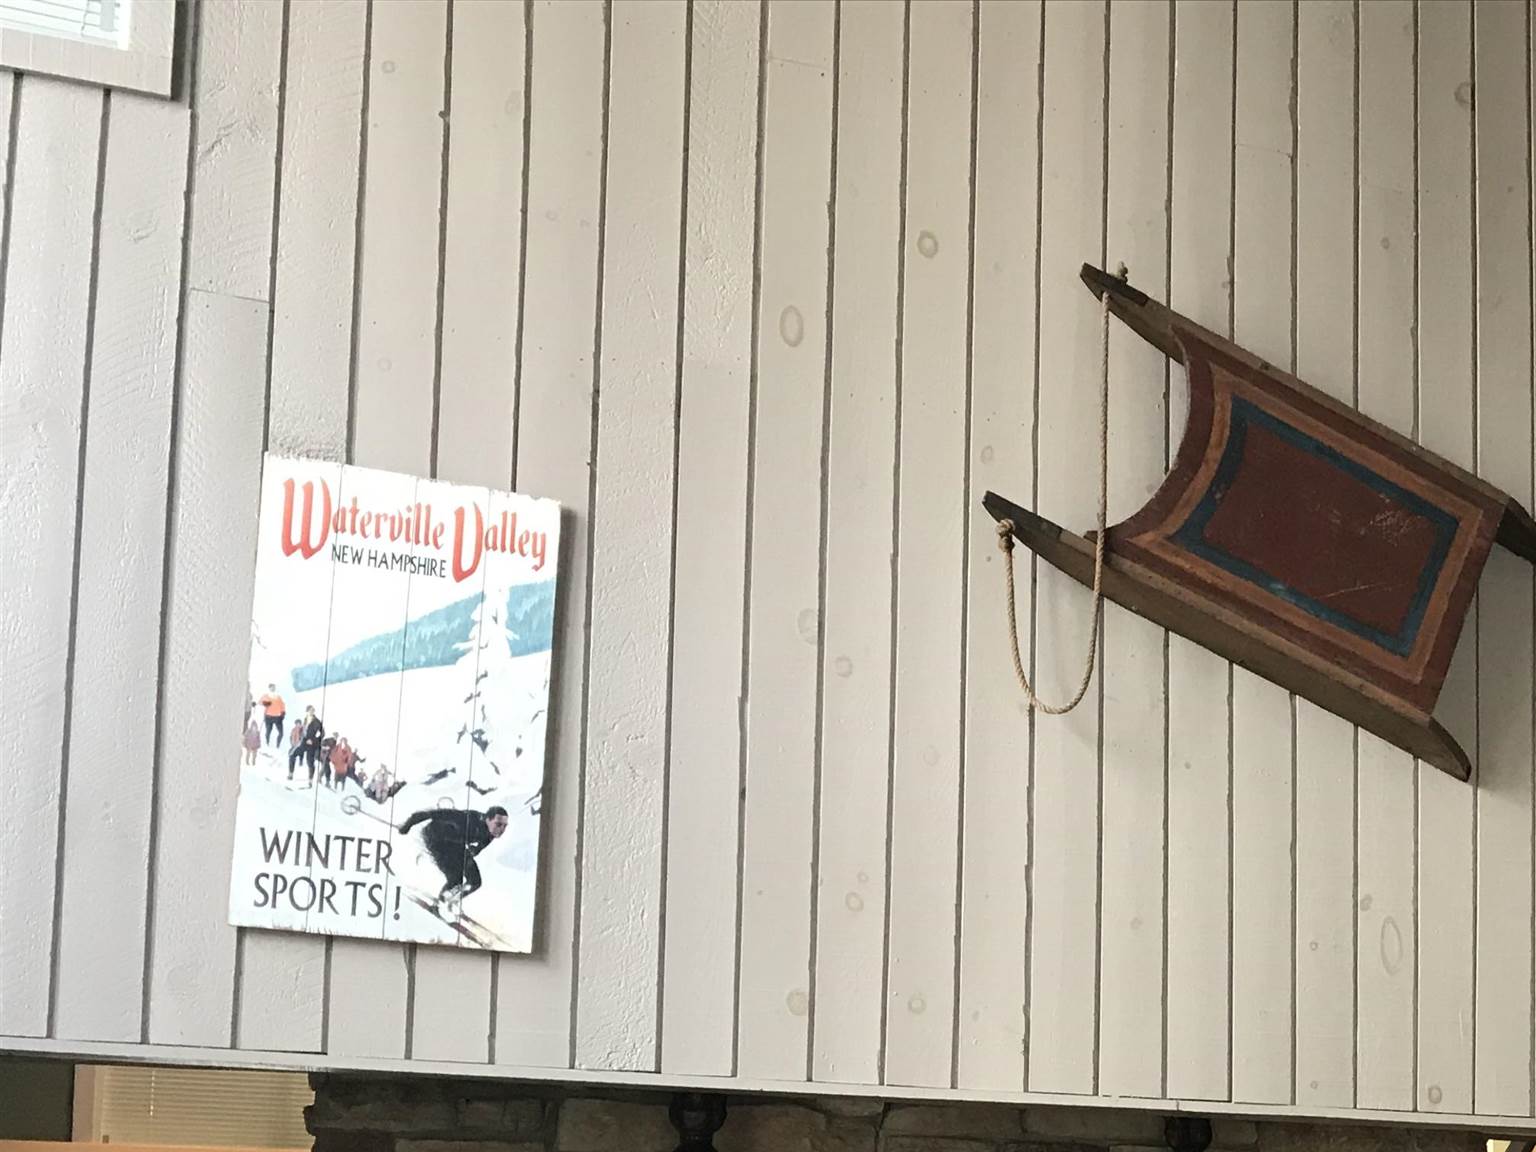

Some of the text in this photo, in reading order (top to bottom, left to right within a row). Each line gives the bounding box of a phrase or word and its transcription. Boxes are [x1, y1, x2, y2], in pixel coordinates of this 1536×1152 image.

[281, 477, 547, 583] Waterville Valley
[331, 544, 447, 579] NEW HAMPSHIRE
[259, 827, 393, 876] WINTER
[253, 872, 402, 921] SPORTS!
